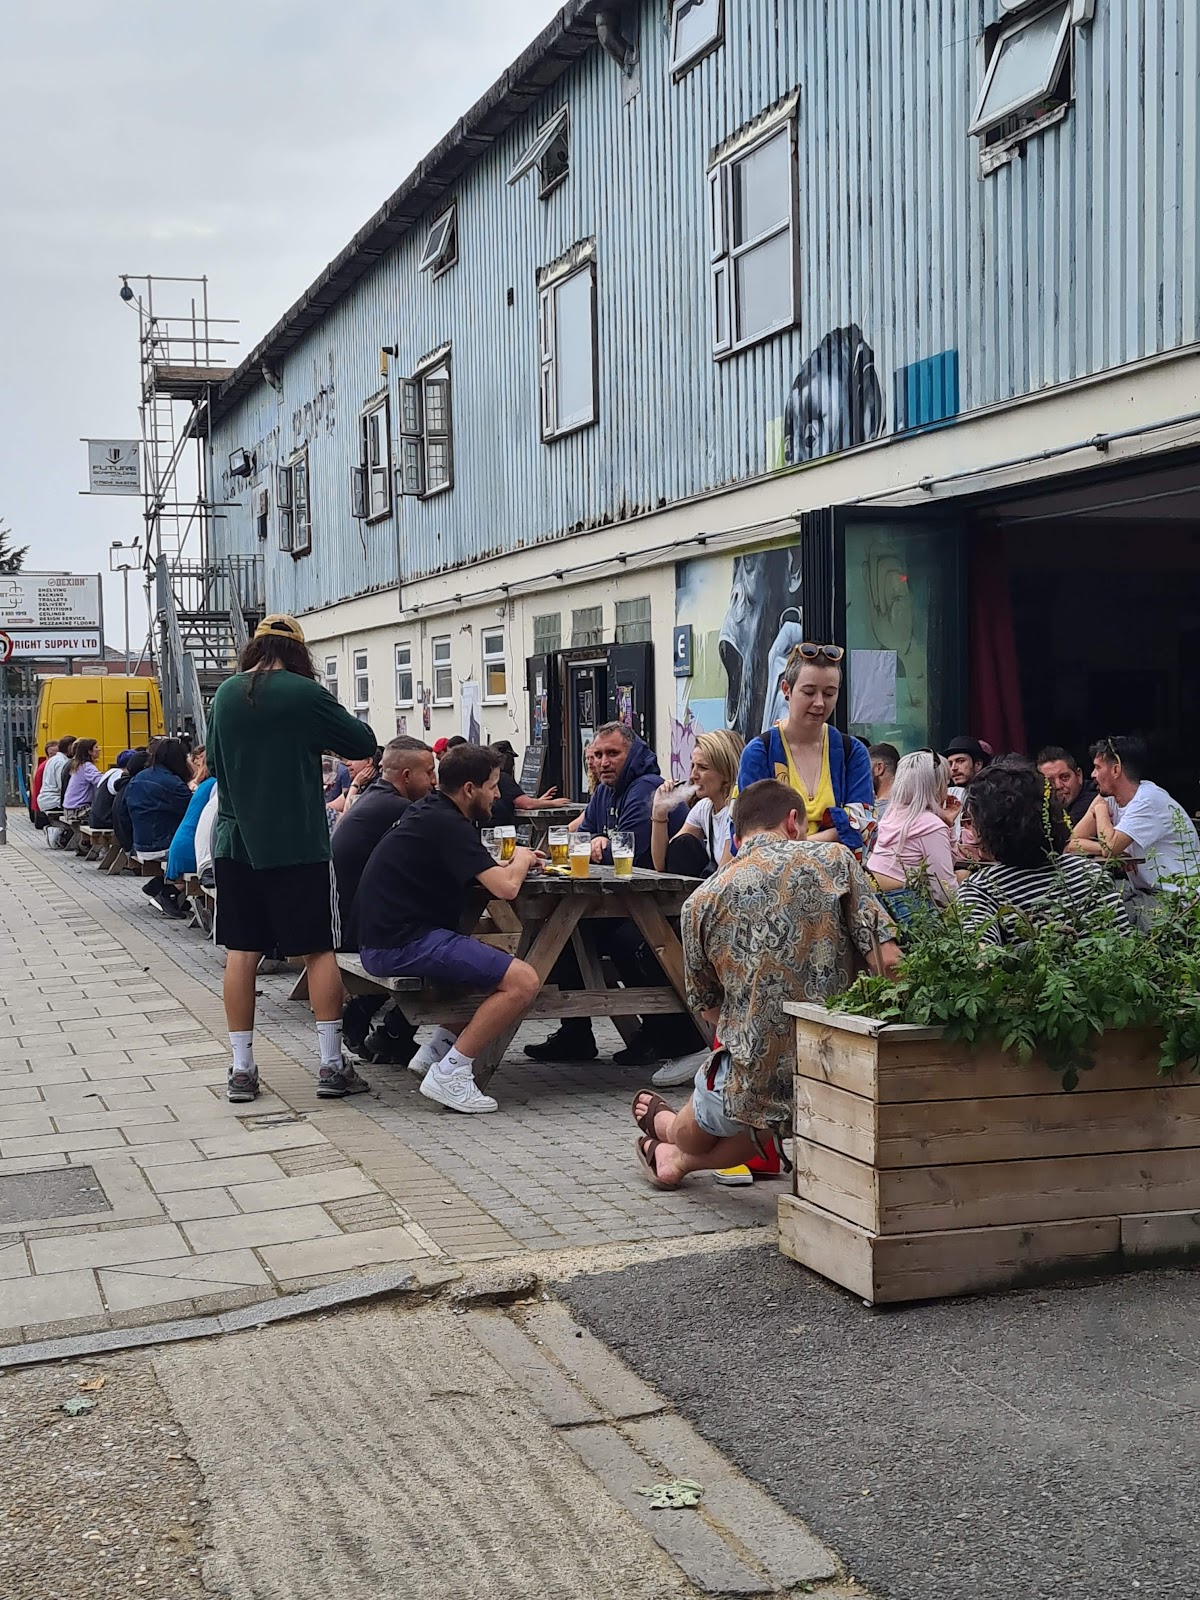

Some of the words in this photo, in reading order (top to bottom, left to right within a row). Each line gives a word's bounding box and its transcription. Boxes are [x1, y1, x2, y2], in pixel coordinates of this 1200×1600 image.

[56, 578, 85, 586] DEXION
[13, 640, 42, 650] RIGHT
[45, 639, 78, 649] SUPPLY
[82, 639, 97, 648] LTD
[677, 634, 686, 658] E
